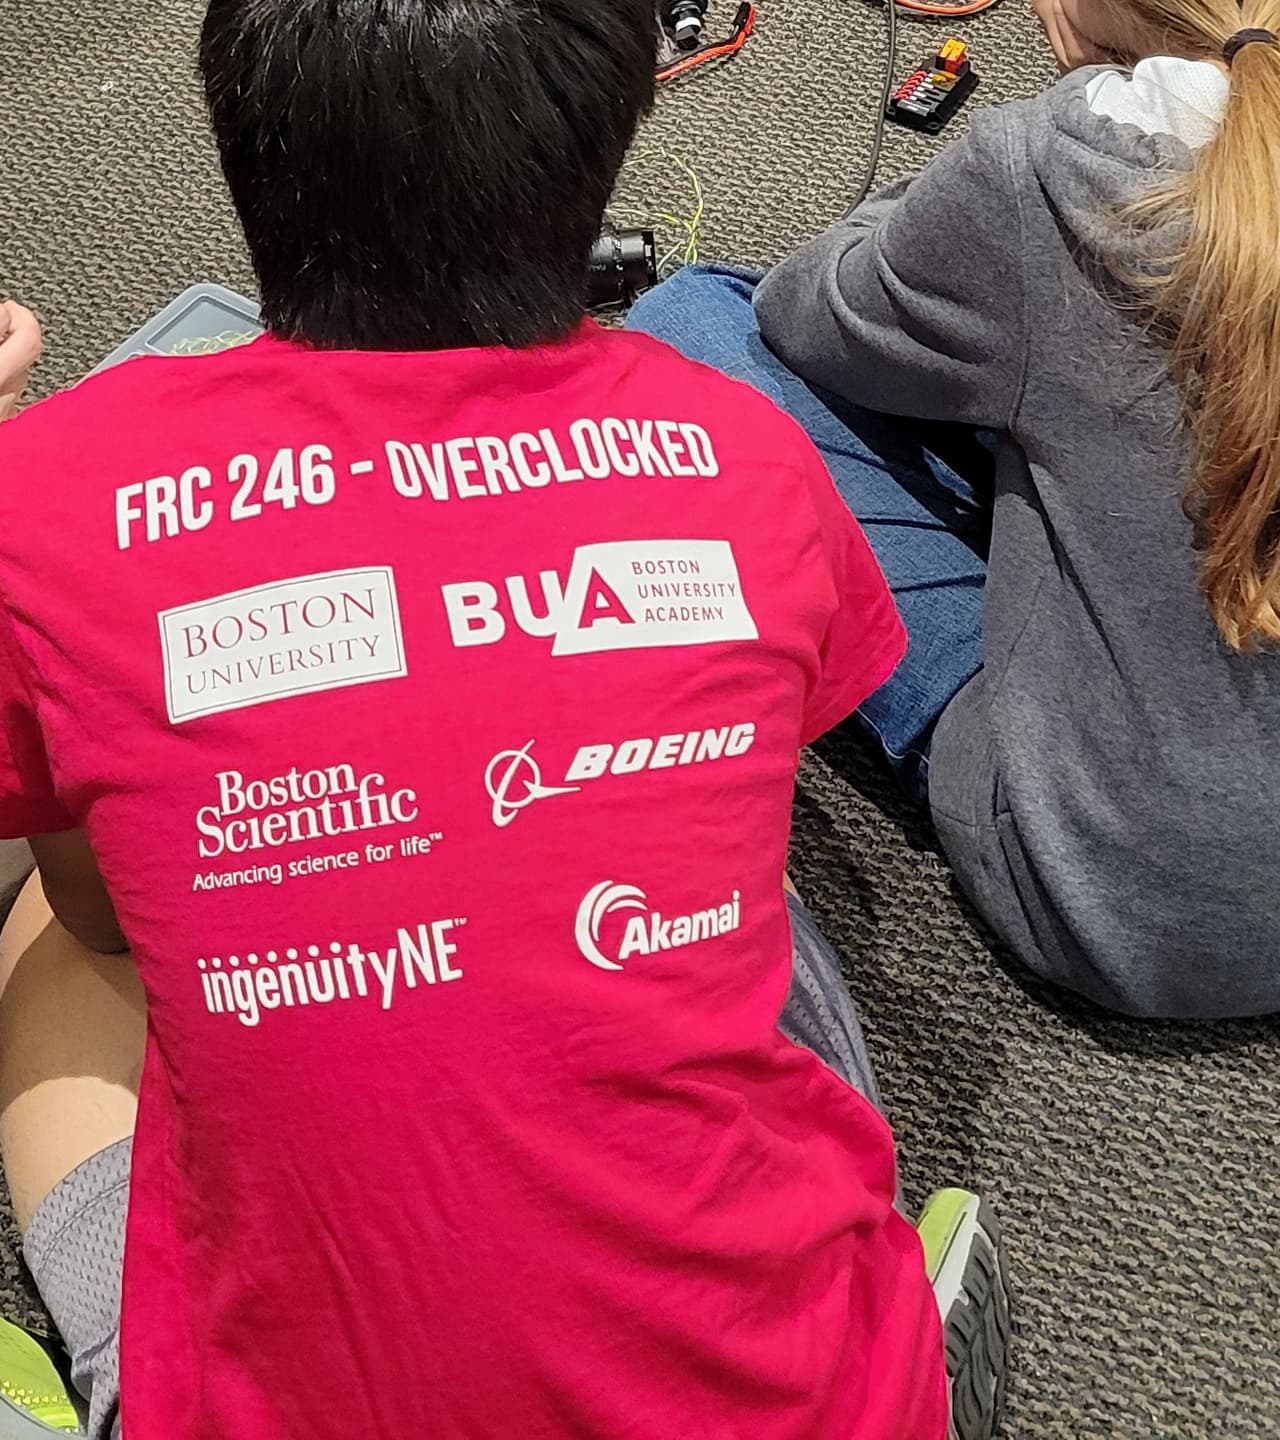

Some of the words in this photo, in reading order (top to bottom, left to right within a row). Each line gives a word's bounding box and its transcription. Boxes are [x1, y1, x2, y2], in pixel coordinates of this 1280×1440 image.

[115, 466, 213, 550] FRC
[228, 444, 335, 521] 246
[350, 460, 374, 475] -
[385, 418, 719, 500] OVERCLOCKED
[631, 559, 701, 575] BOSTON
[637, 582, 736, 599] UNIVERSITY
[183, 588, 376, 659] BOSTON
[441, 566, 636, 648] BUA
[644, 606, 724, 623] ACADEMY
[186, 635, 380, 695] UNIVERSITY
[564, 722, 755, 782] BOEING
[196, 773, 419, 858] Scientific
[216, 763, 358, 817] Boston
[192, 862, 283, 891] Advancing
[288, 849, 359, 877] science
[365, 844, 394, 863] for
[618, 889, 740, 960] Akamai
